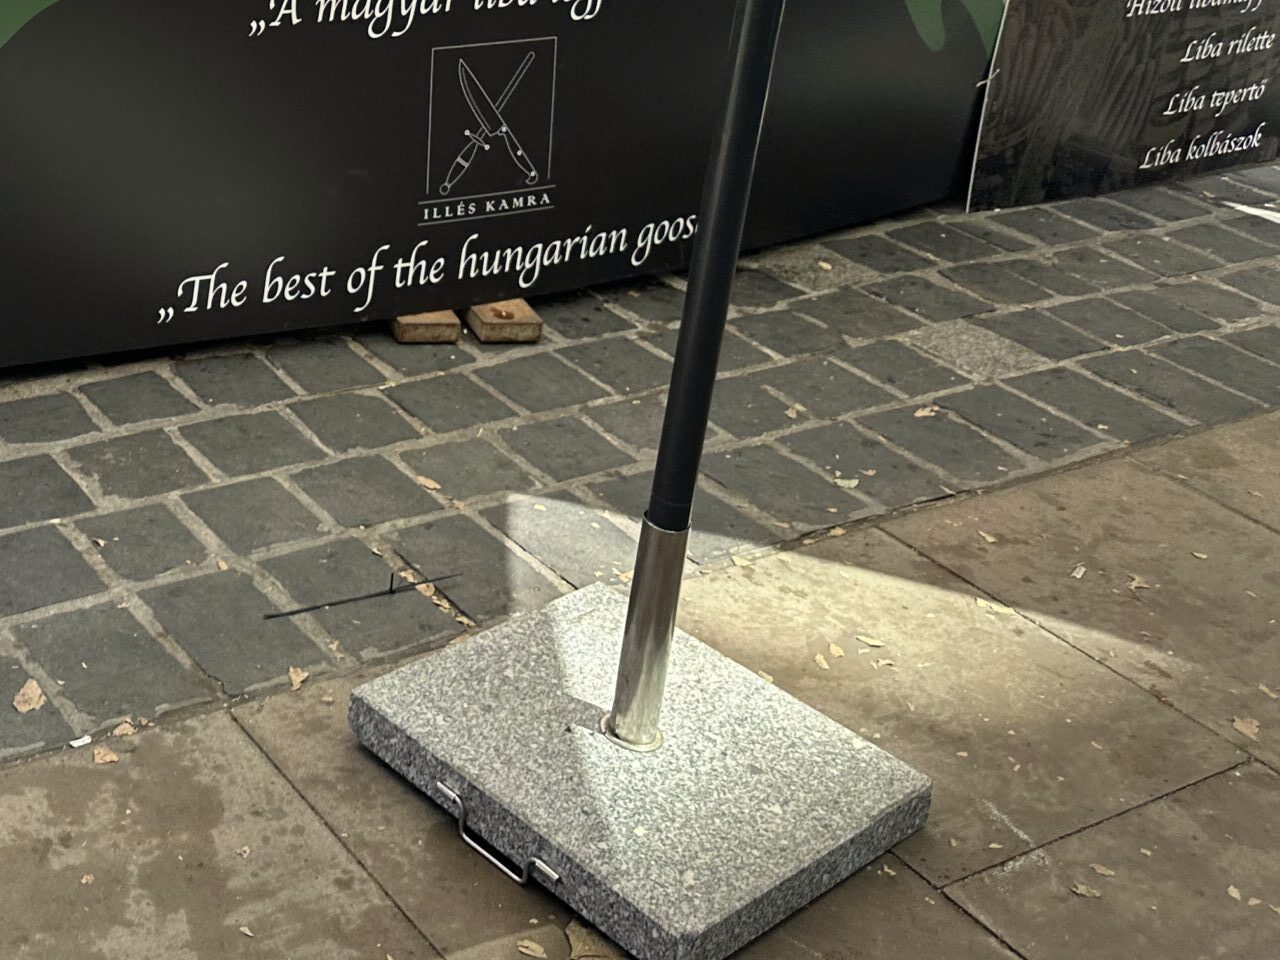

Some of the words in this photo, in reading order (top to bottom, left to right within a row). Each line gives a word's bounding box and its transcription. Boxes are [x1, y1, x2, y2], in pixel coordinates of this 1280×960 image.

[1179, 31, 1224, 63] Liba
[1227, 25, 1277, 56] rilette
[1162, 85, 1205, 116] Liba
[1138, 138, 1183, 170] Liba
[1185, 121, 1267, 161] kolbászok
[423, 201, 477, 220] ILLÉS
[485, 193, 551, 212] KAMRA
[261, 254, 336, 304] best
[346, 244, 391, 313] of
[393, 240, 445, 291] the
[457, 222, 629, 288] hungarian
[630, 214, 699, 268] goos
